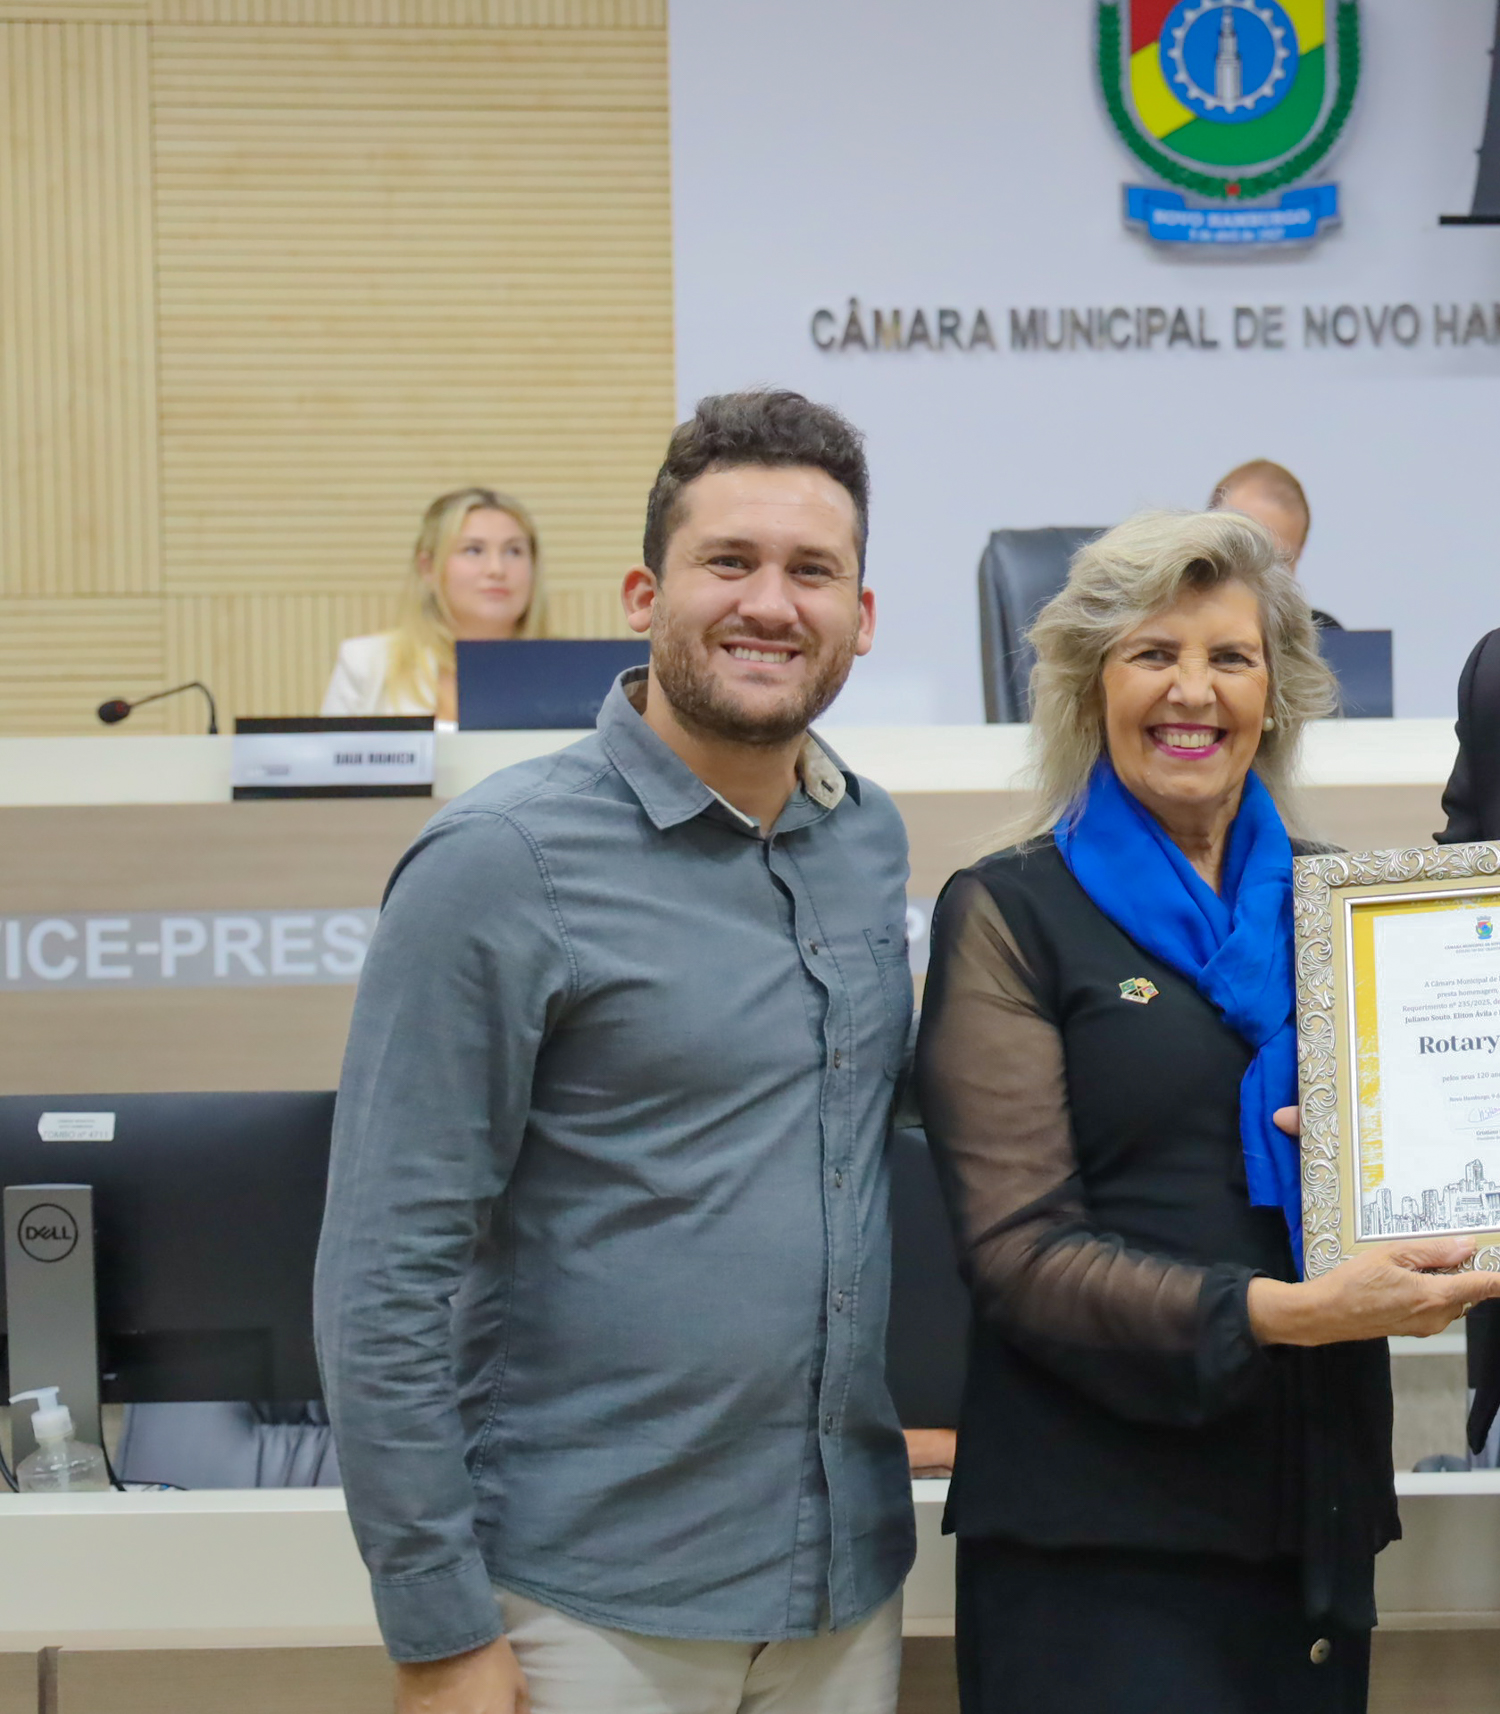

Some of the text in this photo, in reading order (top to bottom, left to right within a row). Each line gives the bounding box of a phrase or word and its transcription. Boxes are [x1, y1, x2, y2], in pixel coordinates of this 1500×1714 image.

[811, 297, 997, 352] CÂMARA
[1010, 307, 1219, 351] MUNICIPAL
[1233, 306, 1286, 350] DE
[1303, 304, 1421, 348] NOVO
[0, 914, 372, 981] ICE-PRES
[1430, 978, 1455, 988] Câmara
[1456, 976, 1488, 987] Municipal
[1437, 990, 1457, 999] presta
[1402, 1002, 1448, 1013] Requerimento
[1405, 1015, 1430, 1025] Juliano
[1453, 1012, 1474, 1020] Eliton
[1475, 1009, 1492, 1018] Ávila
[1419, 1034, 1500, 1054] Rotary
[1442, 1074, 1459, 1084] pelos
[26, 1226, 72, 1240] DELL
